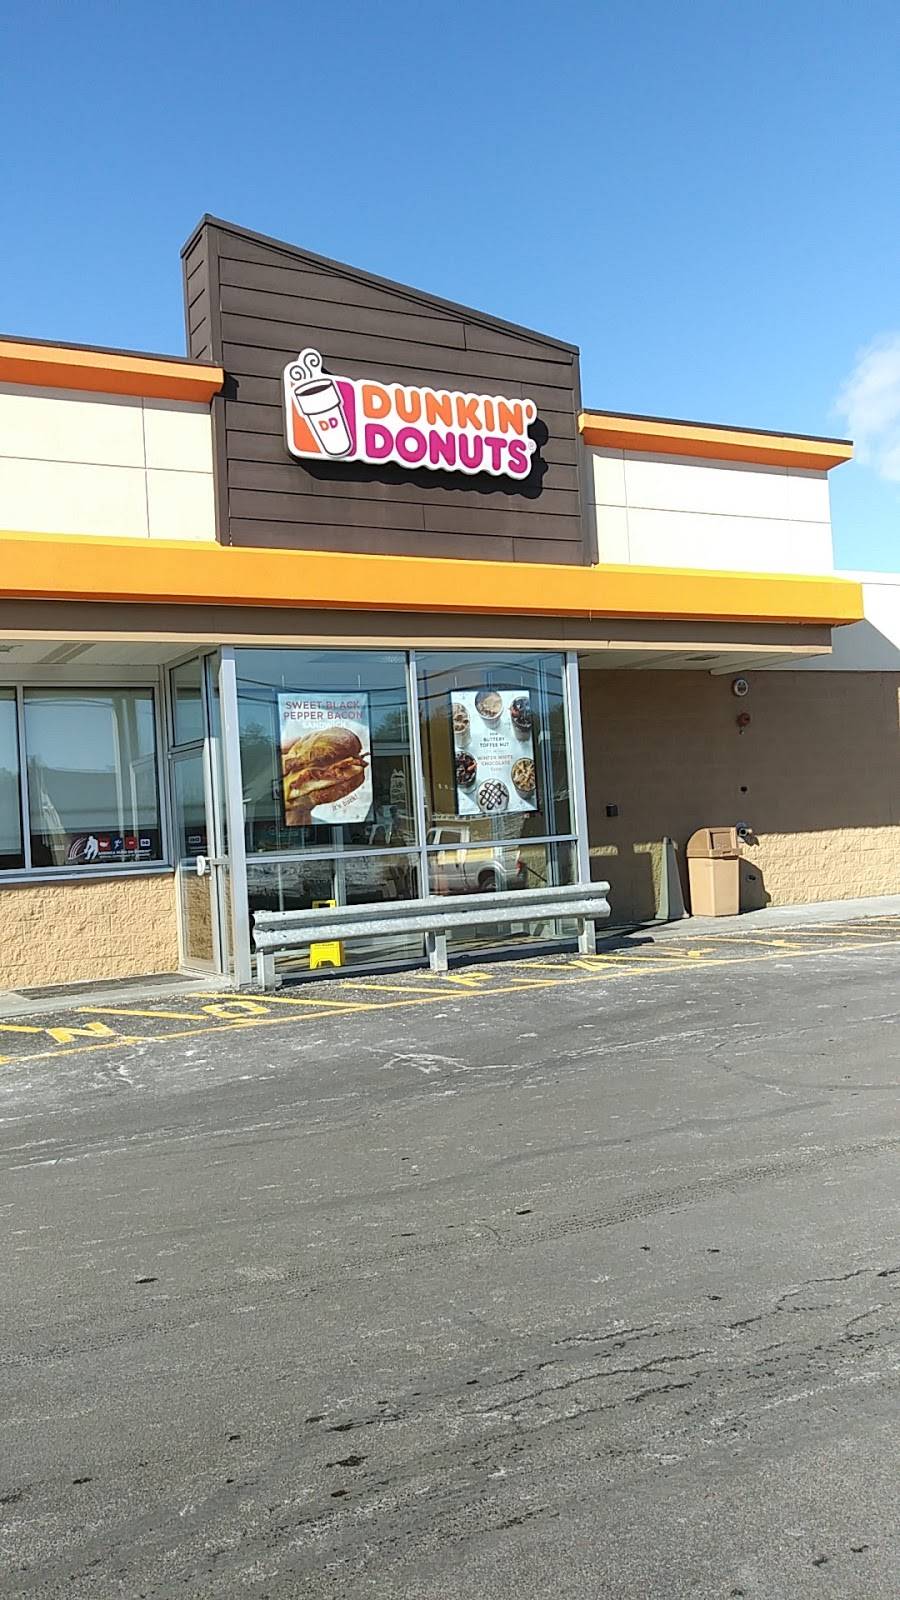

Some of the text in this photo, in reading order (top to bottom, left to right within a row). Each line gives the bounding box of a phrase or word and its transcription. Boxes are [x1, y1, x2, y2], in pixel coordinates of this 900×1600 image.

[362, 384, 533, 435] DUNKIN'
[318, 417, 339, 431] DD
[365, 423, 528, 473] DONUTS
[286, 701, 360, 710] SWEET BLACK
[283, 711, 364, 720] PEPPER BACON
